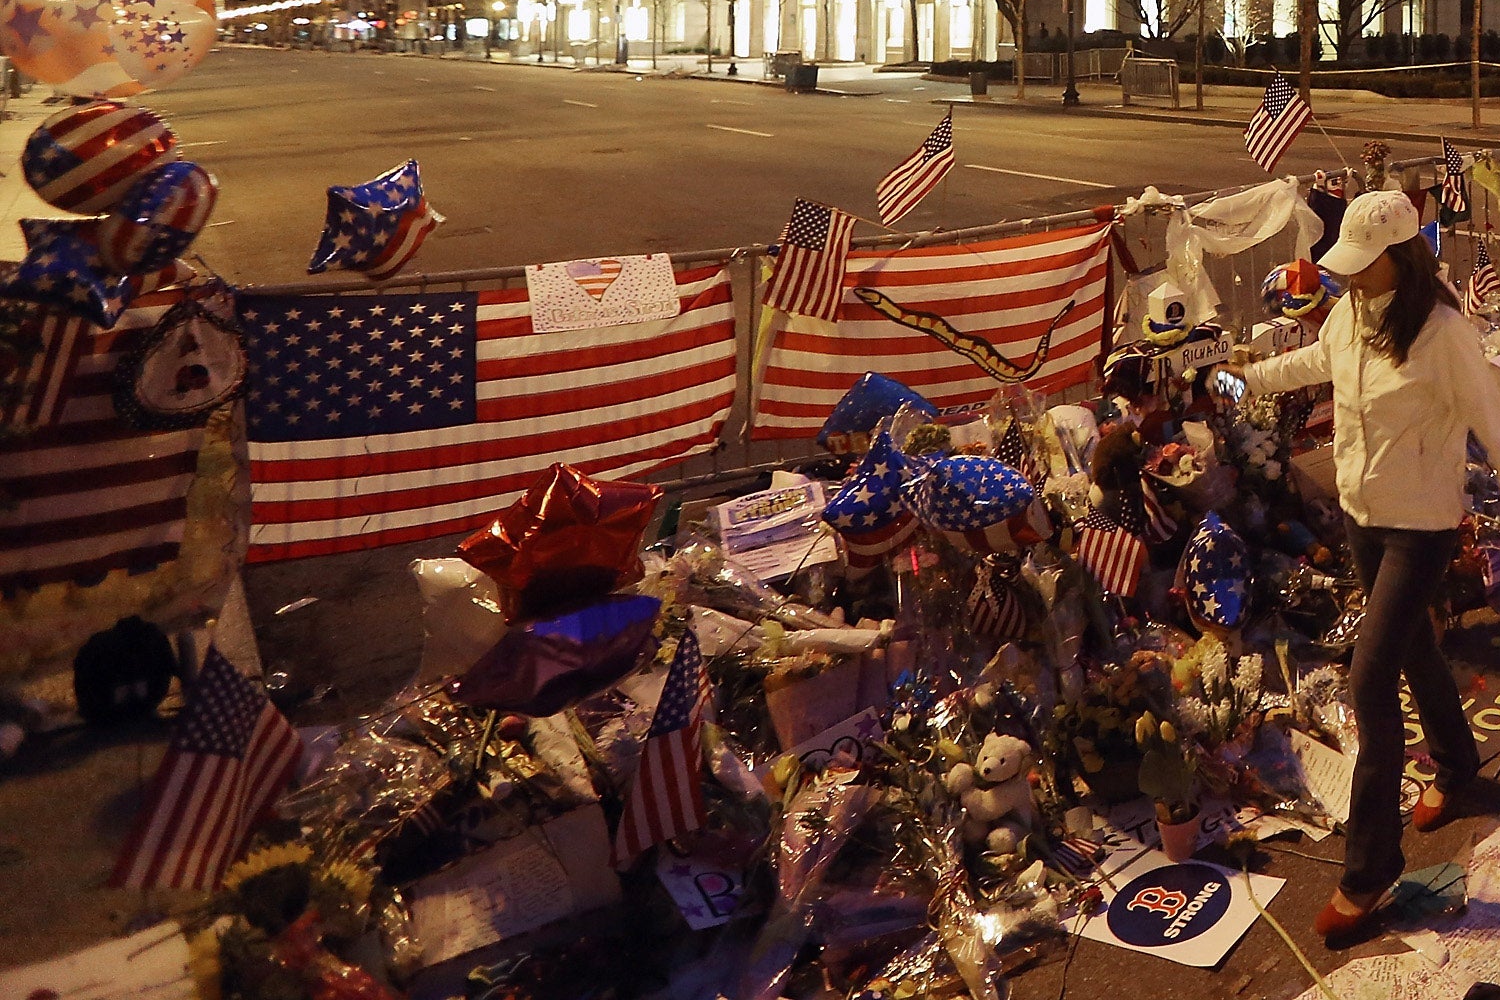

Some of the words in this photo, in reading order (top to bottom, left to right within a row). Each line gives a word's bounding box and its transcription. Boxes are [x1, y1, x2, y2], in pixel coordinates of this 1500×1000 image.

[1182, 340, 1229, 367] RICHARD
[1127, 886, 1188, 920] B
[1163, 881, 1222, 939] STRONG
